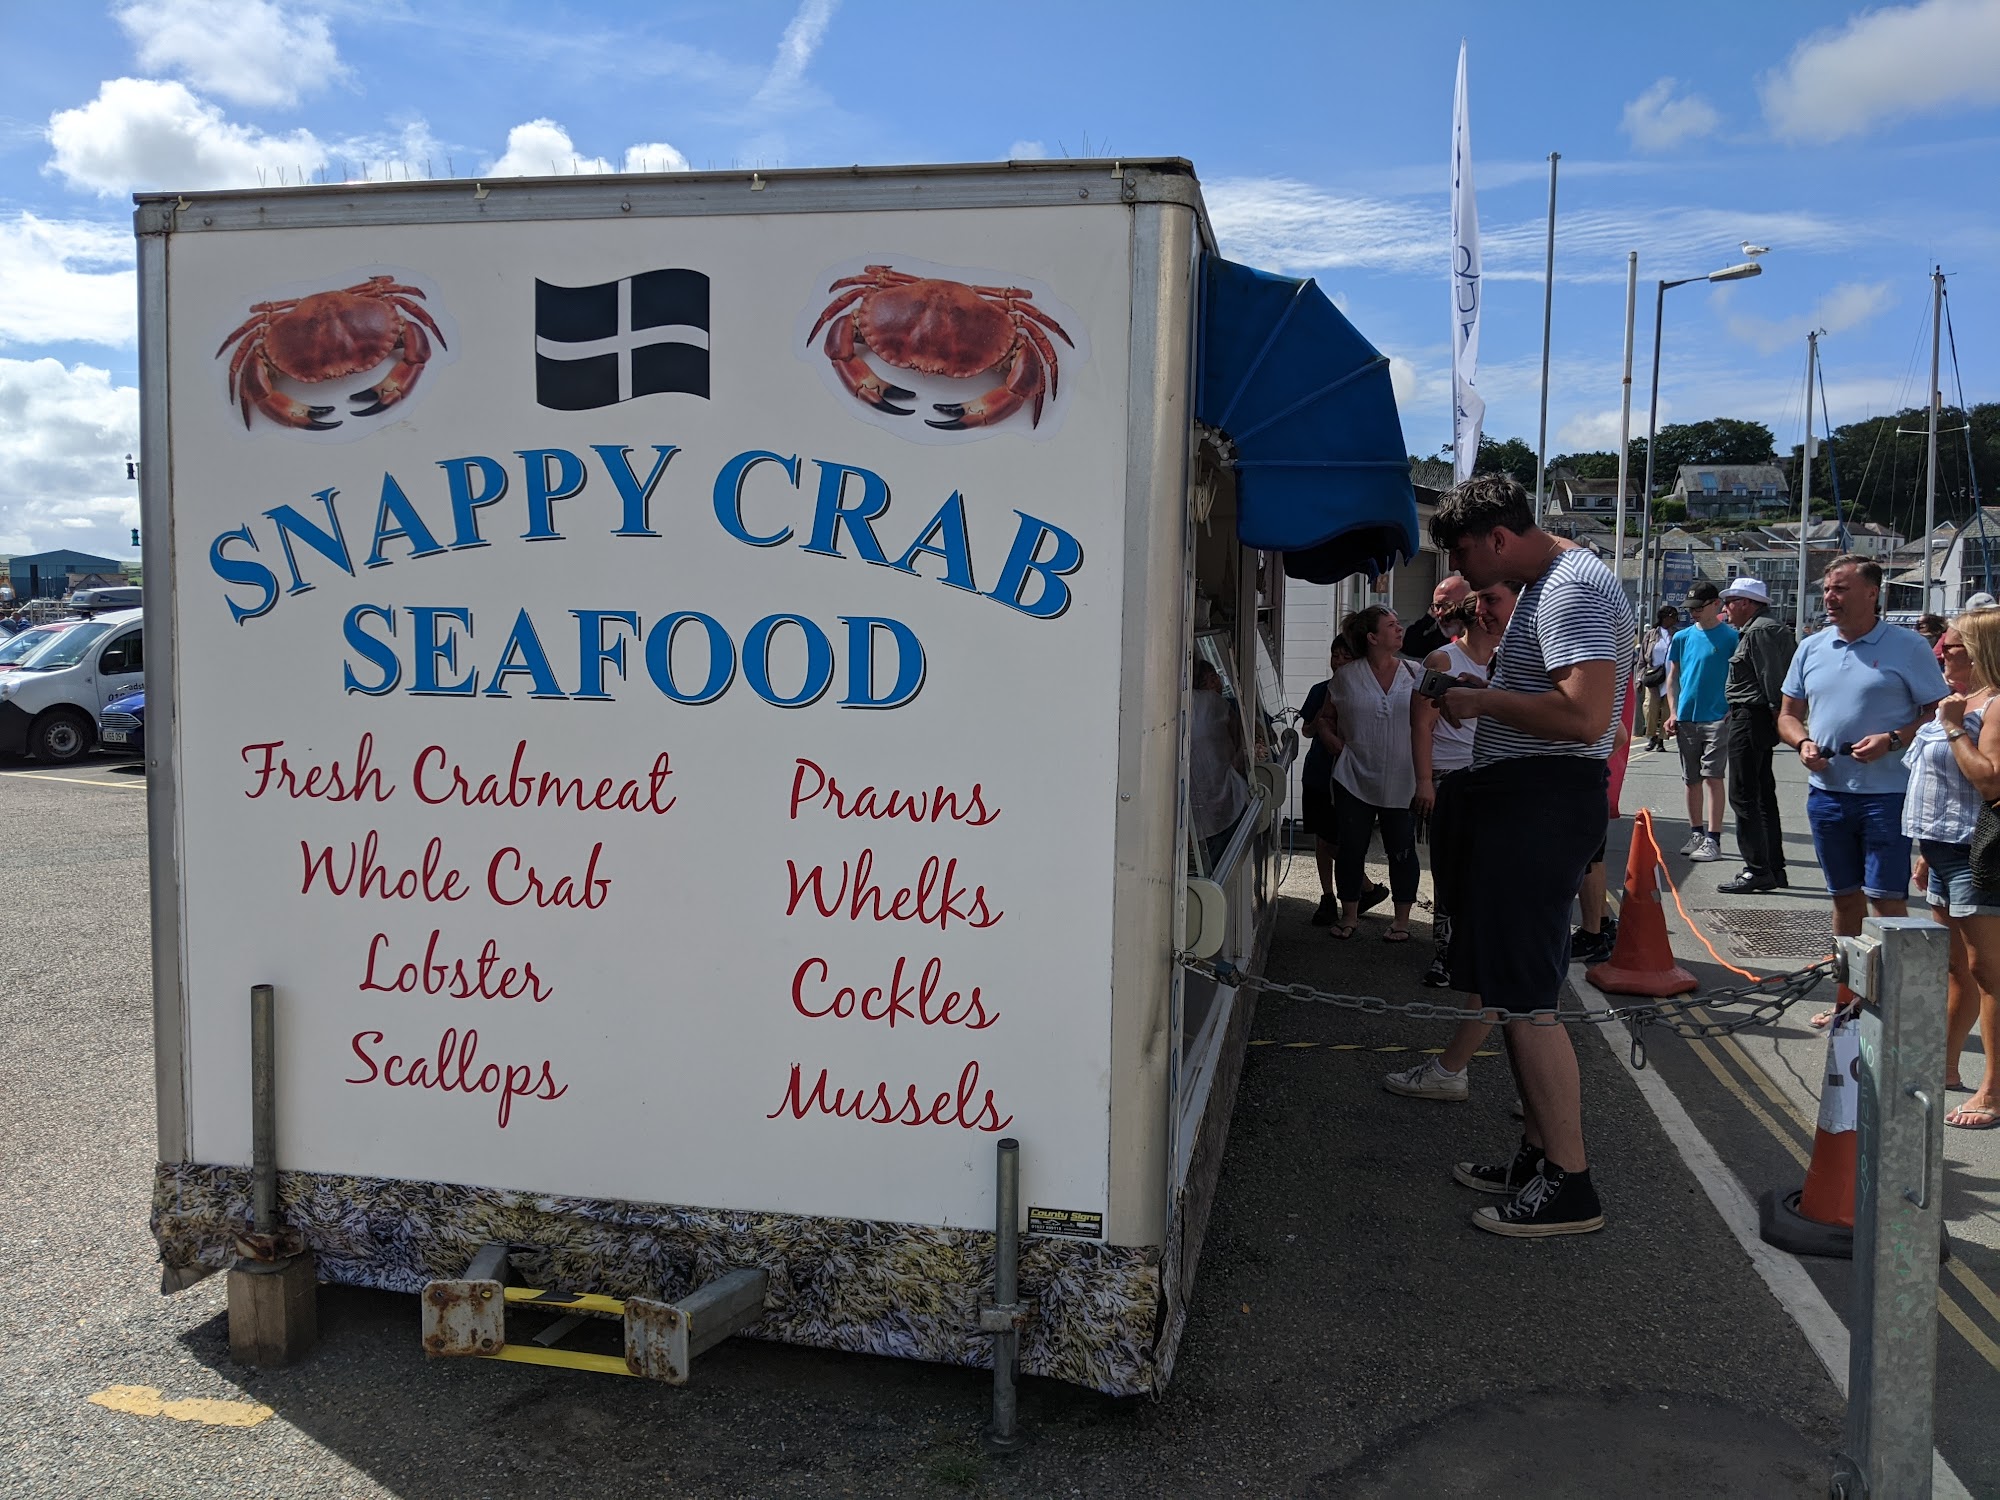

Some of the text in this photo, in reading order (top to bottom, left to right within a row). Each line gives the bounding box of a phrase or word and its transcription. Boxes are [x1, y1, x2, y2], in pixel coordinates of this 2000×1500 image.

[210, 445, 1085, 627] SNAPPY CRAB
[344, 604, 926, 710] SEAFOOD
[242, 732, 675, 815] Fresh Crabmeat
[790, 758, 1000, 827] Prawns
[301, 830, 611, 910] Whole Crab
[786, 848, 1003, 929] Whelks
[360, 930, 551, 1002] Lobster
[792, 957, 999, 1029] Cockles
[348, 1028, 566, 1129] Scallops
[768, 1061, 1013, 1132] Mussels
[1030, 1209, 1101, 1222] County Signs
